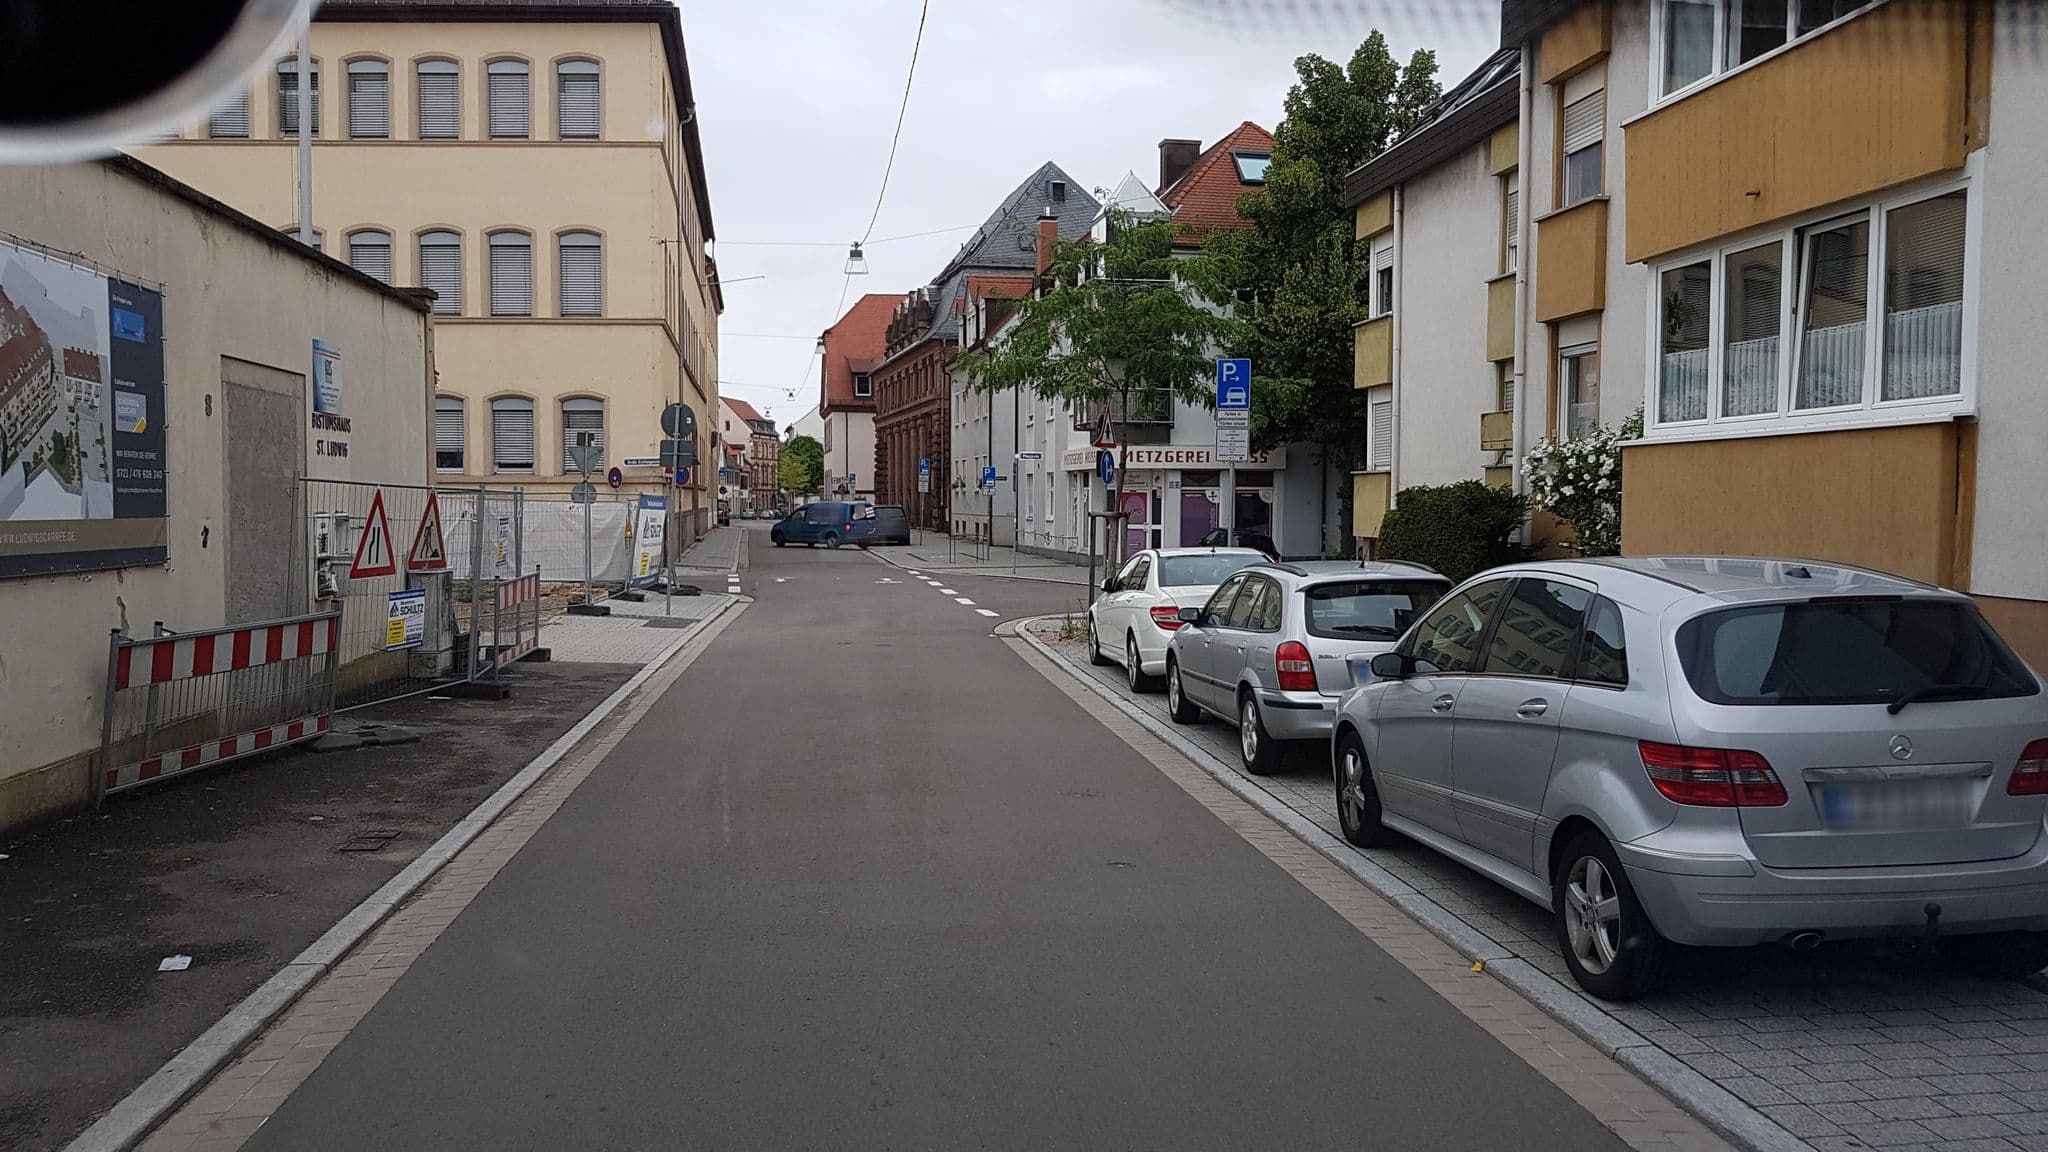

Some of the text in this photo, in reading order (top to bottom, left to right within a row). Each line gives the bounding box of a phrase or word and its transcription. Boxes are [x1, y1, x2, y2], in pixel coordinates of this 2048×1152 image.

[1222, 362, 1237, 382] P
[311, 413, 352, 434] BISTUMSHAUS
[316, 440, 349, 458] ST. LUDWIG
[1126, 450, 1210, 463] METZGEREI
